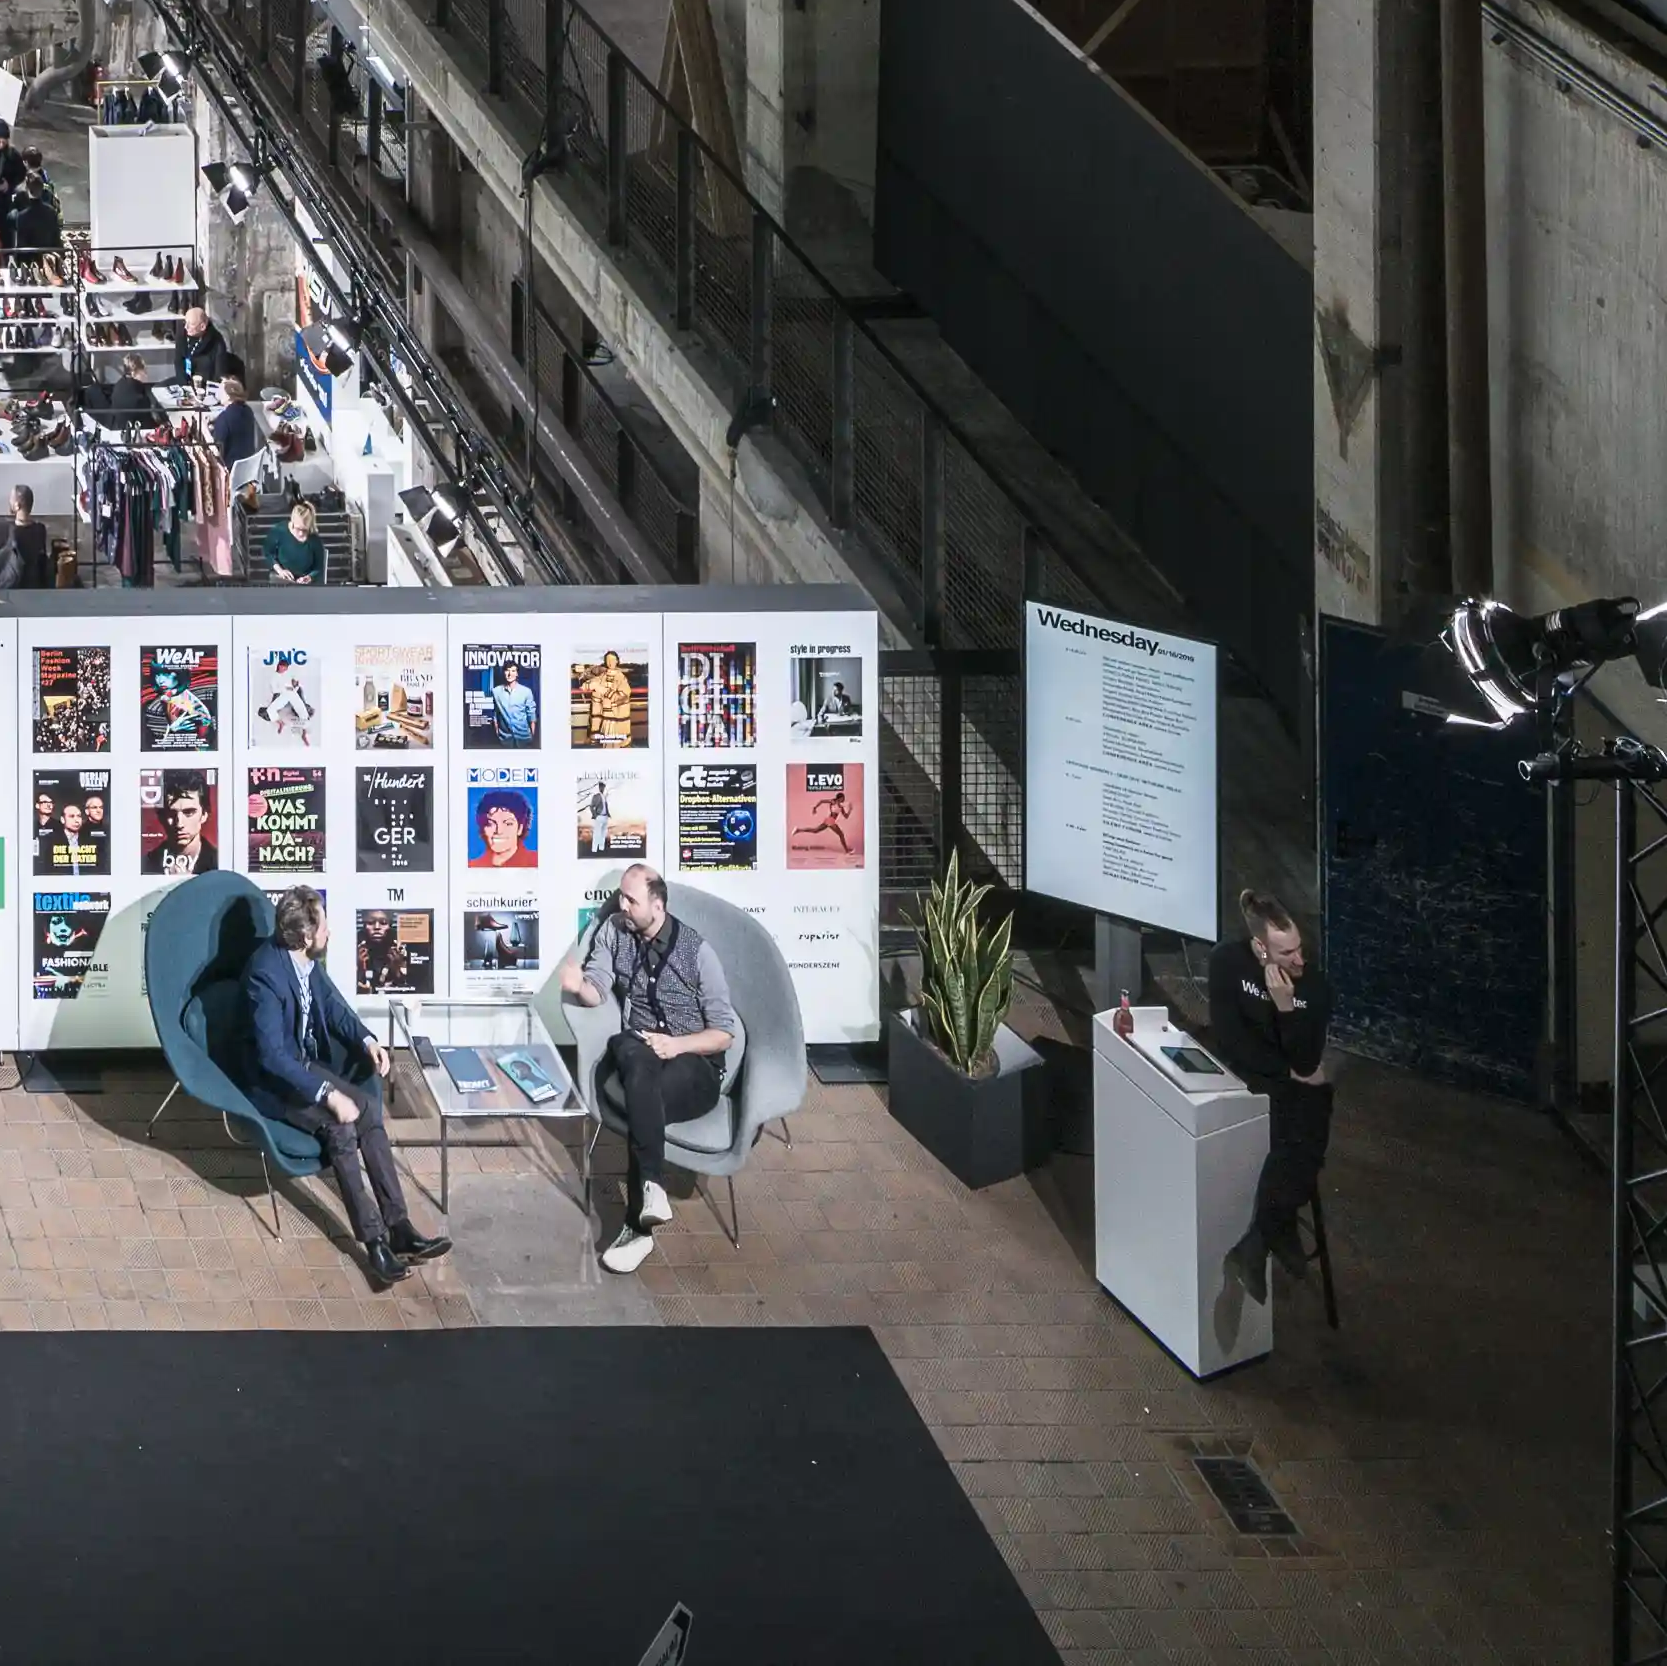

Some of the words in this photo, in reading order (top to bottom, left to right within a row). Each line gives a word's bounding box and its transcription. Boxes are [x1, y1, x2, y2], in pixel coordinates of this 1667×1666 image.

[1037, 608, 1159, 656] Wednesday
[1158, 648, 1195, 663] 01/16/2019
[156, 648, 204, 664] WeAr
[790, 644, 807, 655] style
[809, 644, 815, 655] in
[817, 644, 851, 655] progress
[465, 651, 540, 667] INNOVATOR
[400, 674, 433, 682] BRAND
[375, 772, 424, 789] Hundert
[467, 768, 538, 782] MODEM
[808, 774, 843, 785] T.EVO
[269, 799, 306, 814] WAS
[257, 815, 318, 830] KOMMT
[272, 831, 302, 845] DA-
[374, 828, 415, 844] GER
[53, 845, 66, 854] DIE
[259, 847, 315, 862] NACH?
[387, 889, 404, 901] TM
[1242, 979, 1259, 996] We
